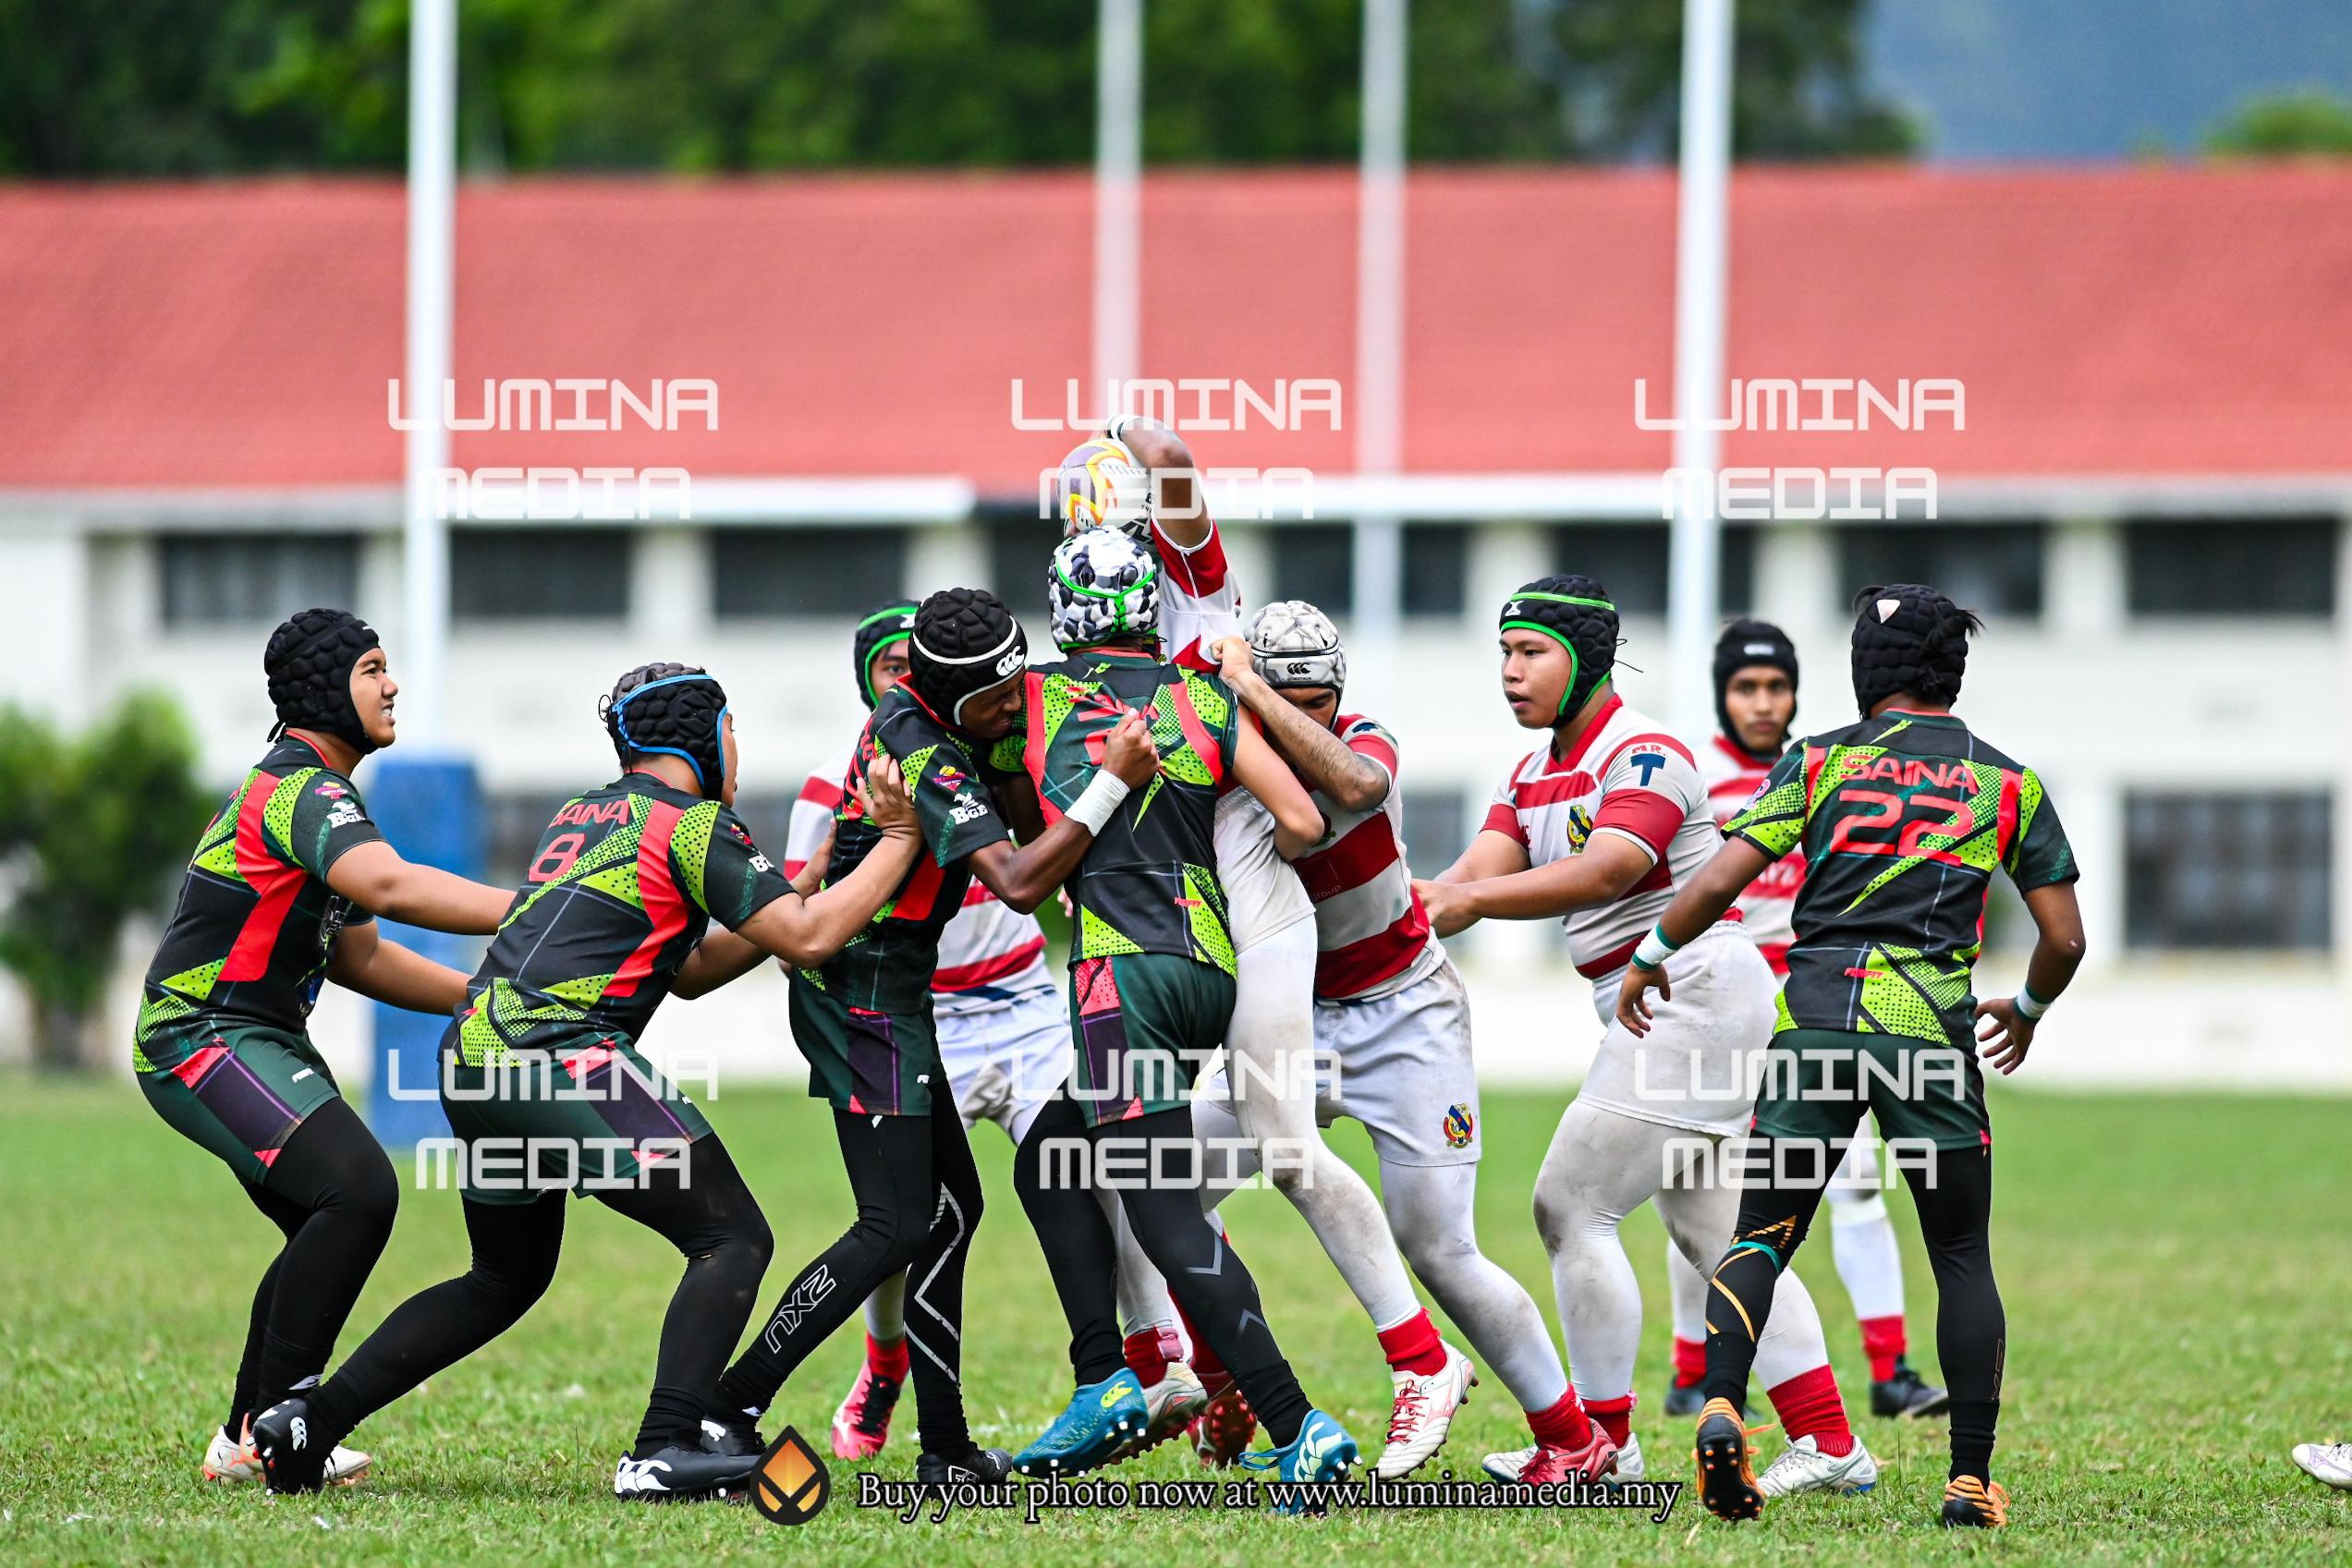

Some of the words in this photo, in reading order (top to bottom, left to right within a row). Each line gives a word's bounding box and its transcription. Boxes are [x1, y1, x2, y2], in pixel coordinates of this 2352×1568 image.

[1630, 753, 1666, 786] T
[1840, 754, 1980, 796] SAINA
[1830, 790, 1976, 867] 22
[529, 833, 586, 881] 8
